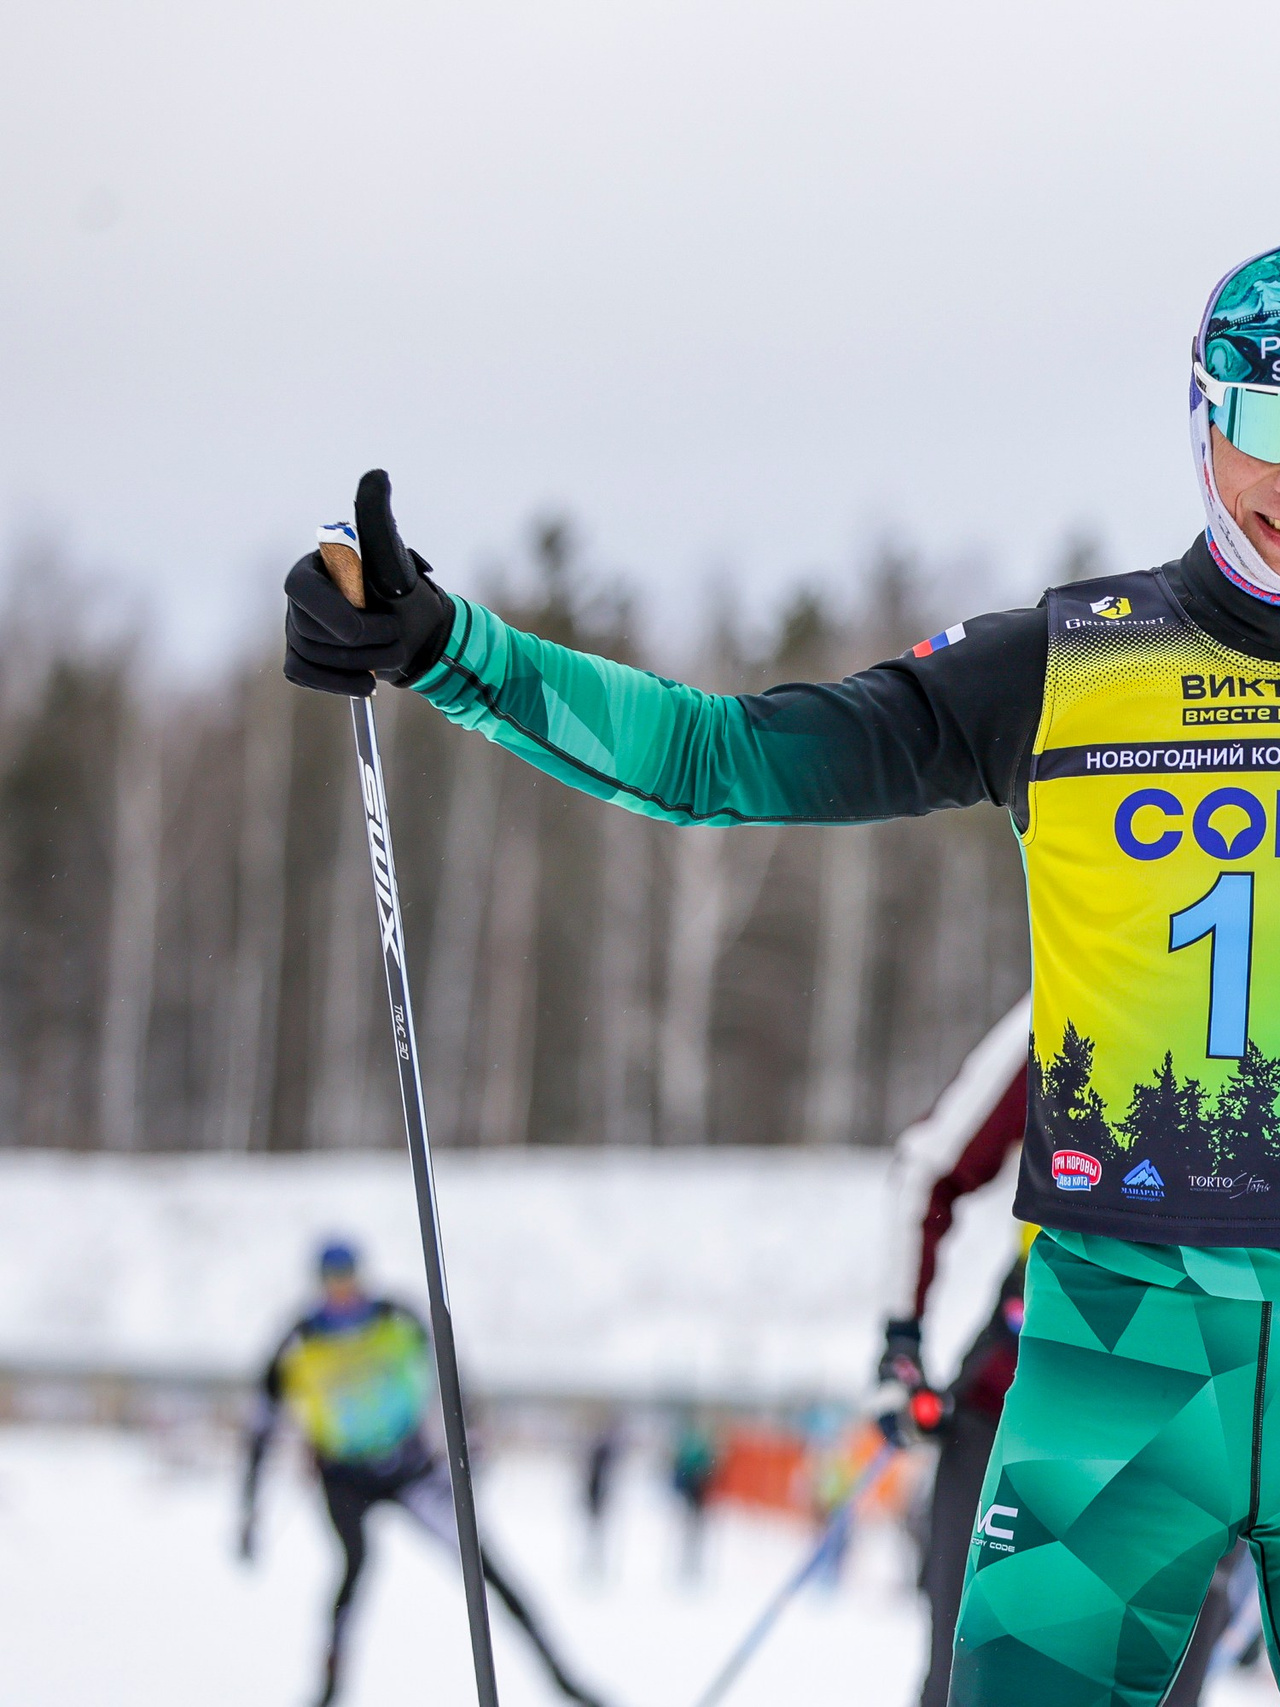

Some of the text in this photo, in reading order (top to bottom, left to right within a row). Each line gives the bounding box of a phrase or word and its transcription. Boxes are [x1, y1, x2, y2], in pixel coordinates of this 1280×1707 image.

[1185, 707, 1270, 723] вместе
[1086, 743, 1244, 769] НОВОГОДНИЙ
[1188, 1175, 1233, 1189] TORTO
[989, 1541, 1016, 1553] CODE
